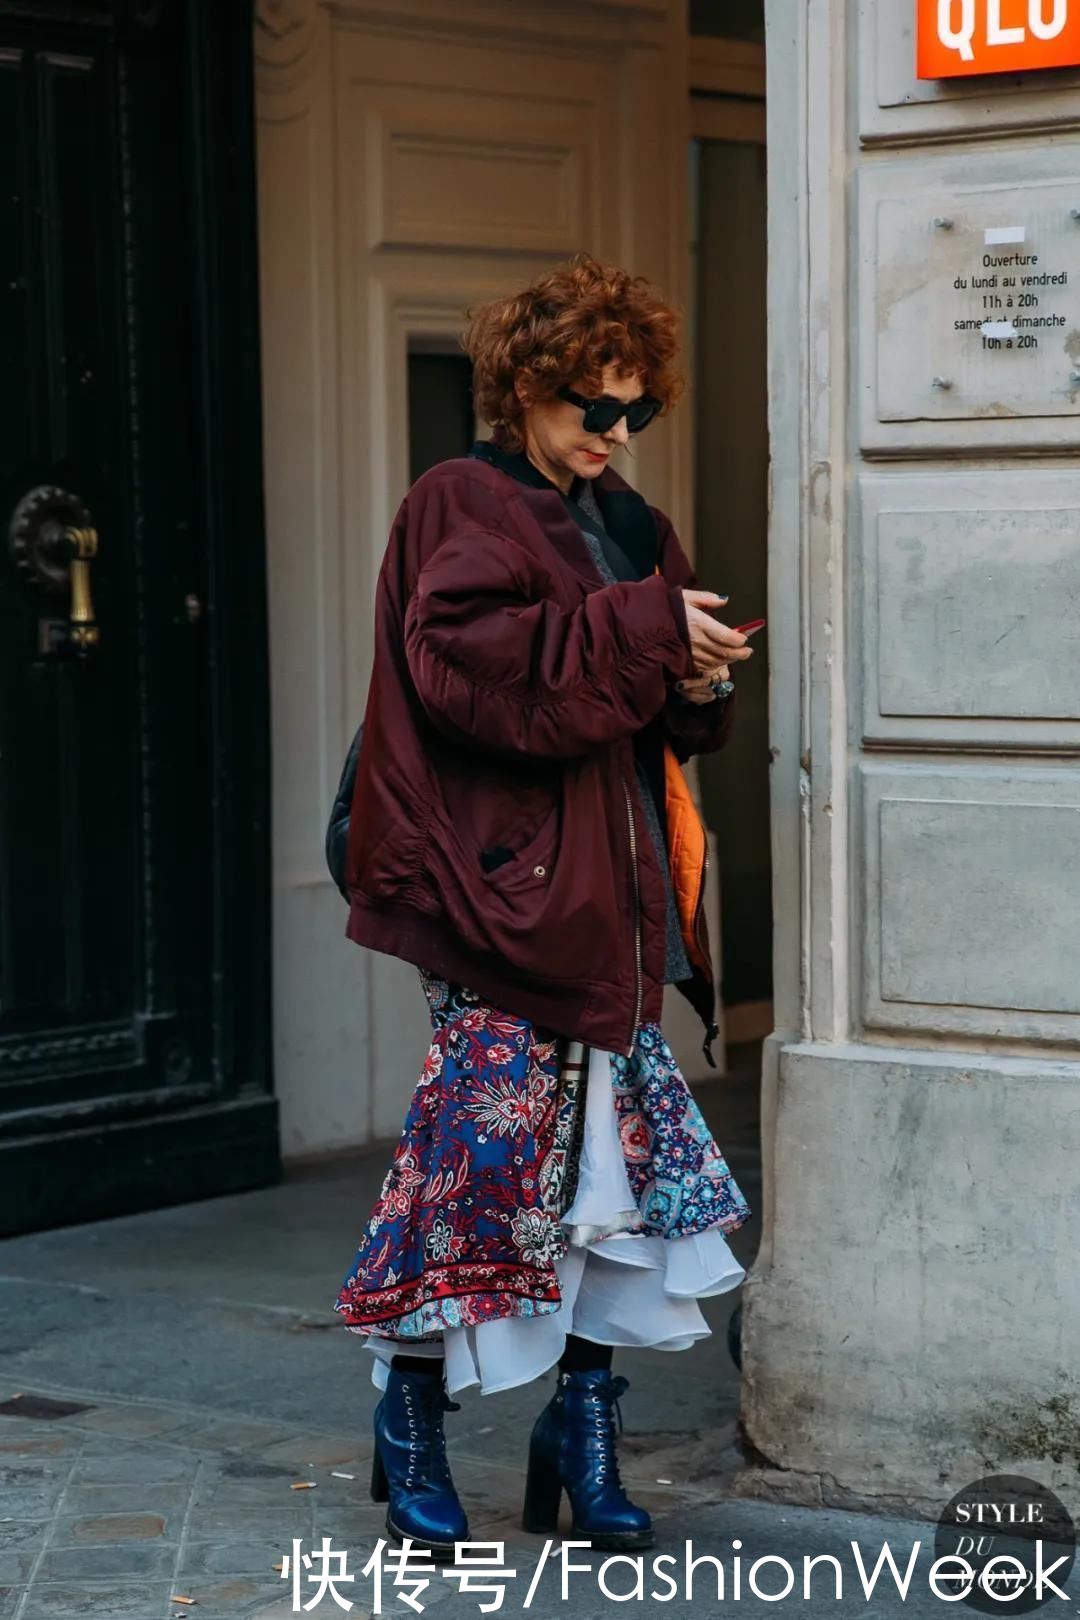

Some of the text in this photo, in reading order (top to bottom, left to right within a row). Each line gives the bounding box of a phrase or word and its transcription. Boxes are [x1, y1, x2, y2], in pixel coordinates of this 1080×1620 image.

[982, 253, 1038, 268] Ouverture
[953, 272, 1068, 290] du lundi au vendredi
[982, 293, 1039, 309] 11h à 20h
[1012, 313, 1067, 328] dimanche
[982, 335, 1002, 350] 10h
[1017, 335, 1039, 349] 20h
